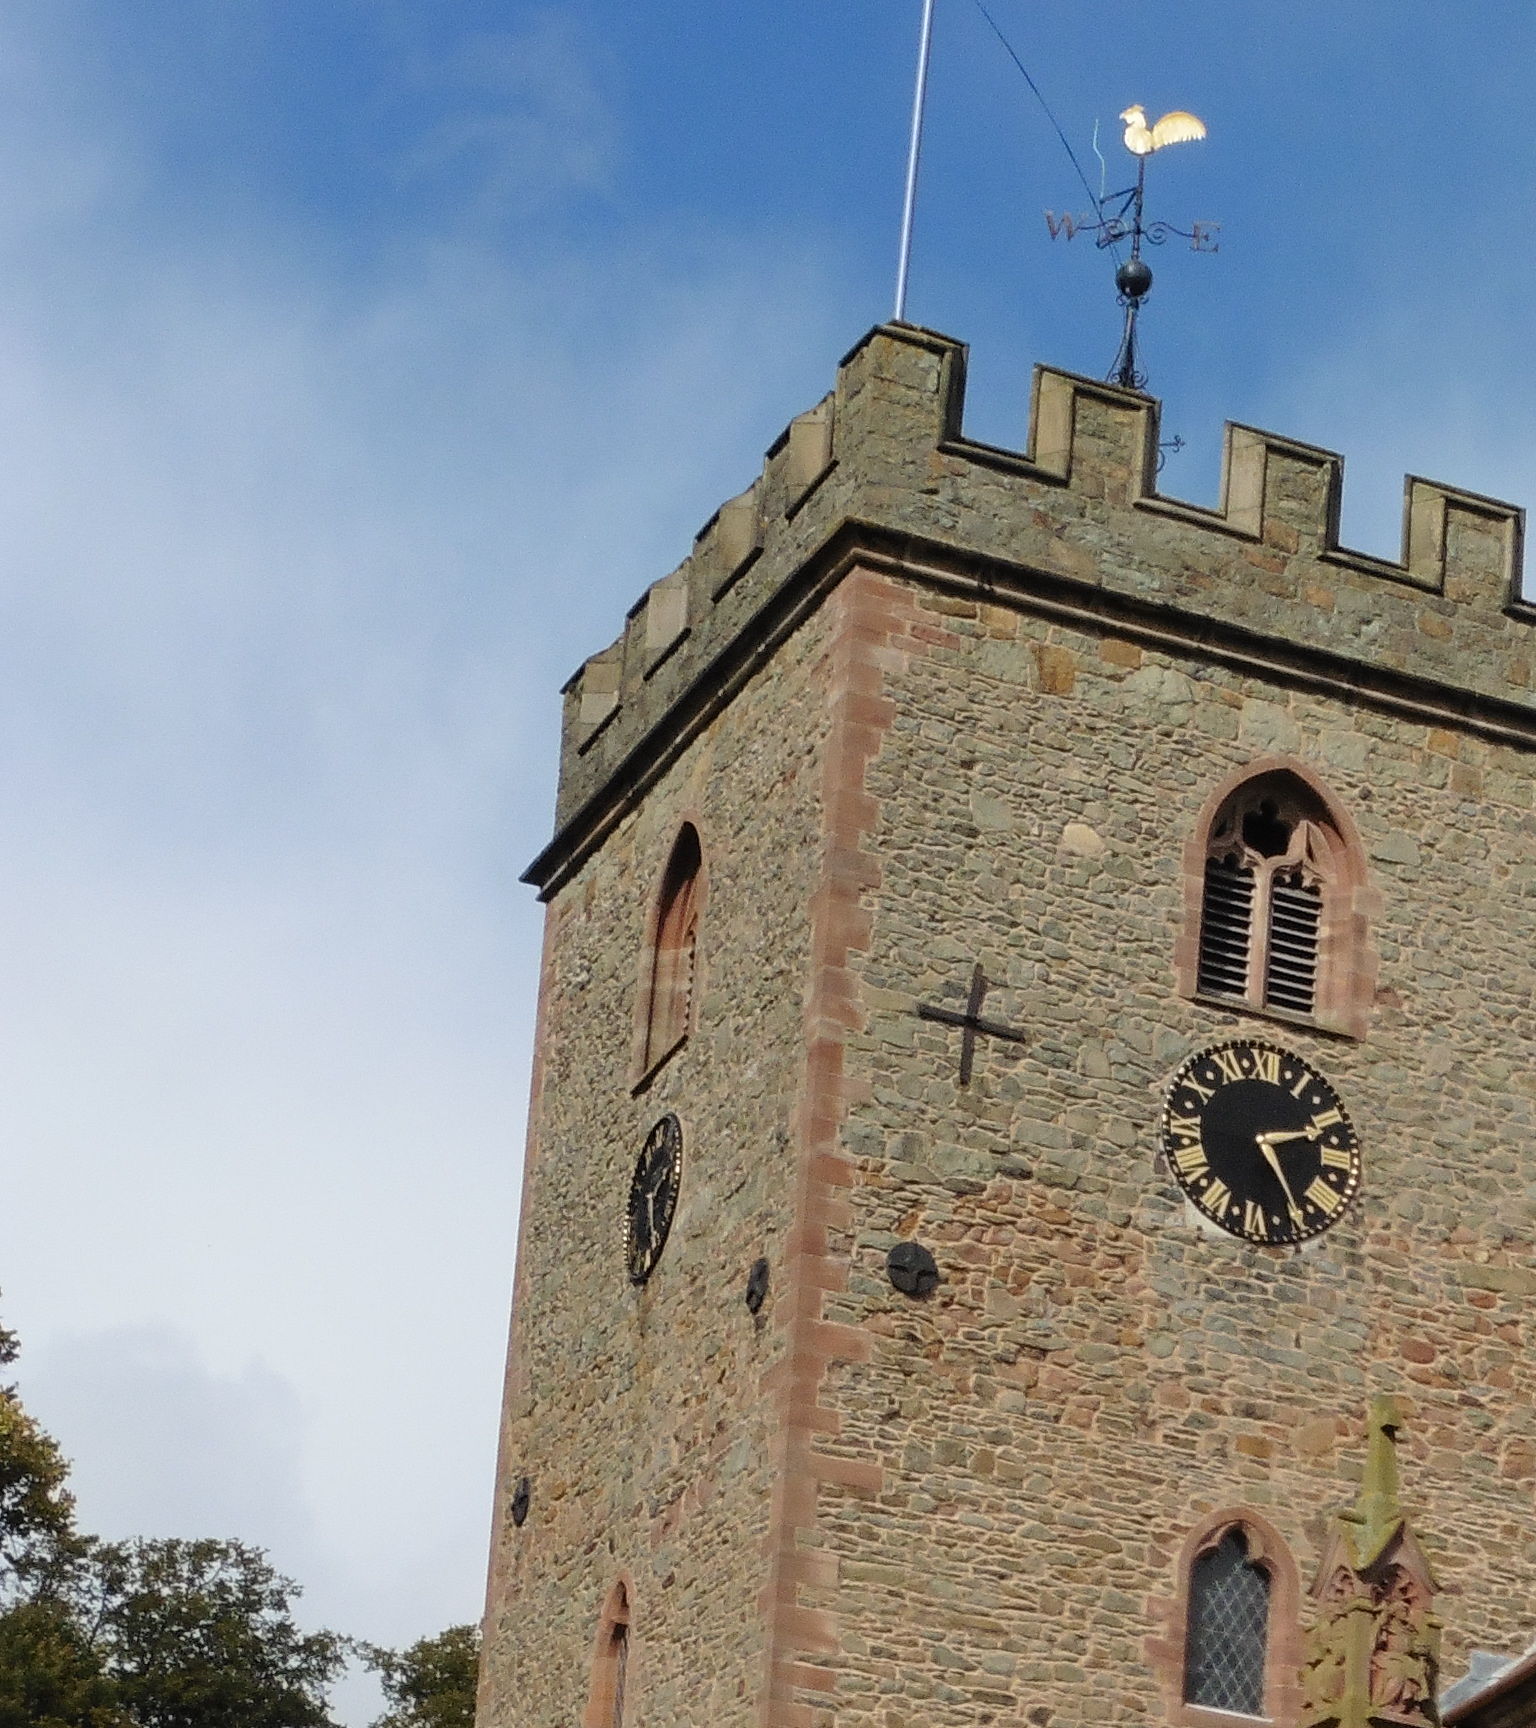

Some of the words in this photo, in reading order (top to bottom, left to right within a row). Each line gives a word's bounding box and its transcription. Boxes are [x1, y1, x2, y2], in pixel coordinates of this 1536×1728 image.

[1190, 221, 1221, 252] E
[1210, 1049, 1246, 1085] XI
[1249, 1049, 1281, 1086] XII
[1181, 1071, 1216, 1105] X
[1290, 1070, 1313, 1099] I
[1321, 1145, 1350, 1171] III
[1245, 1200, 1268, 1236] VI
